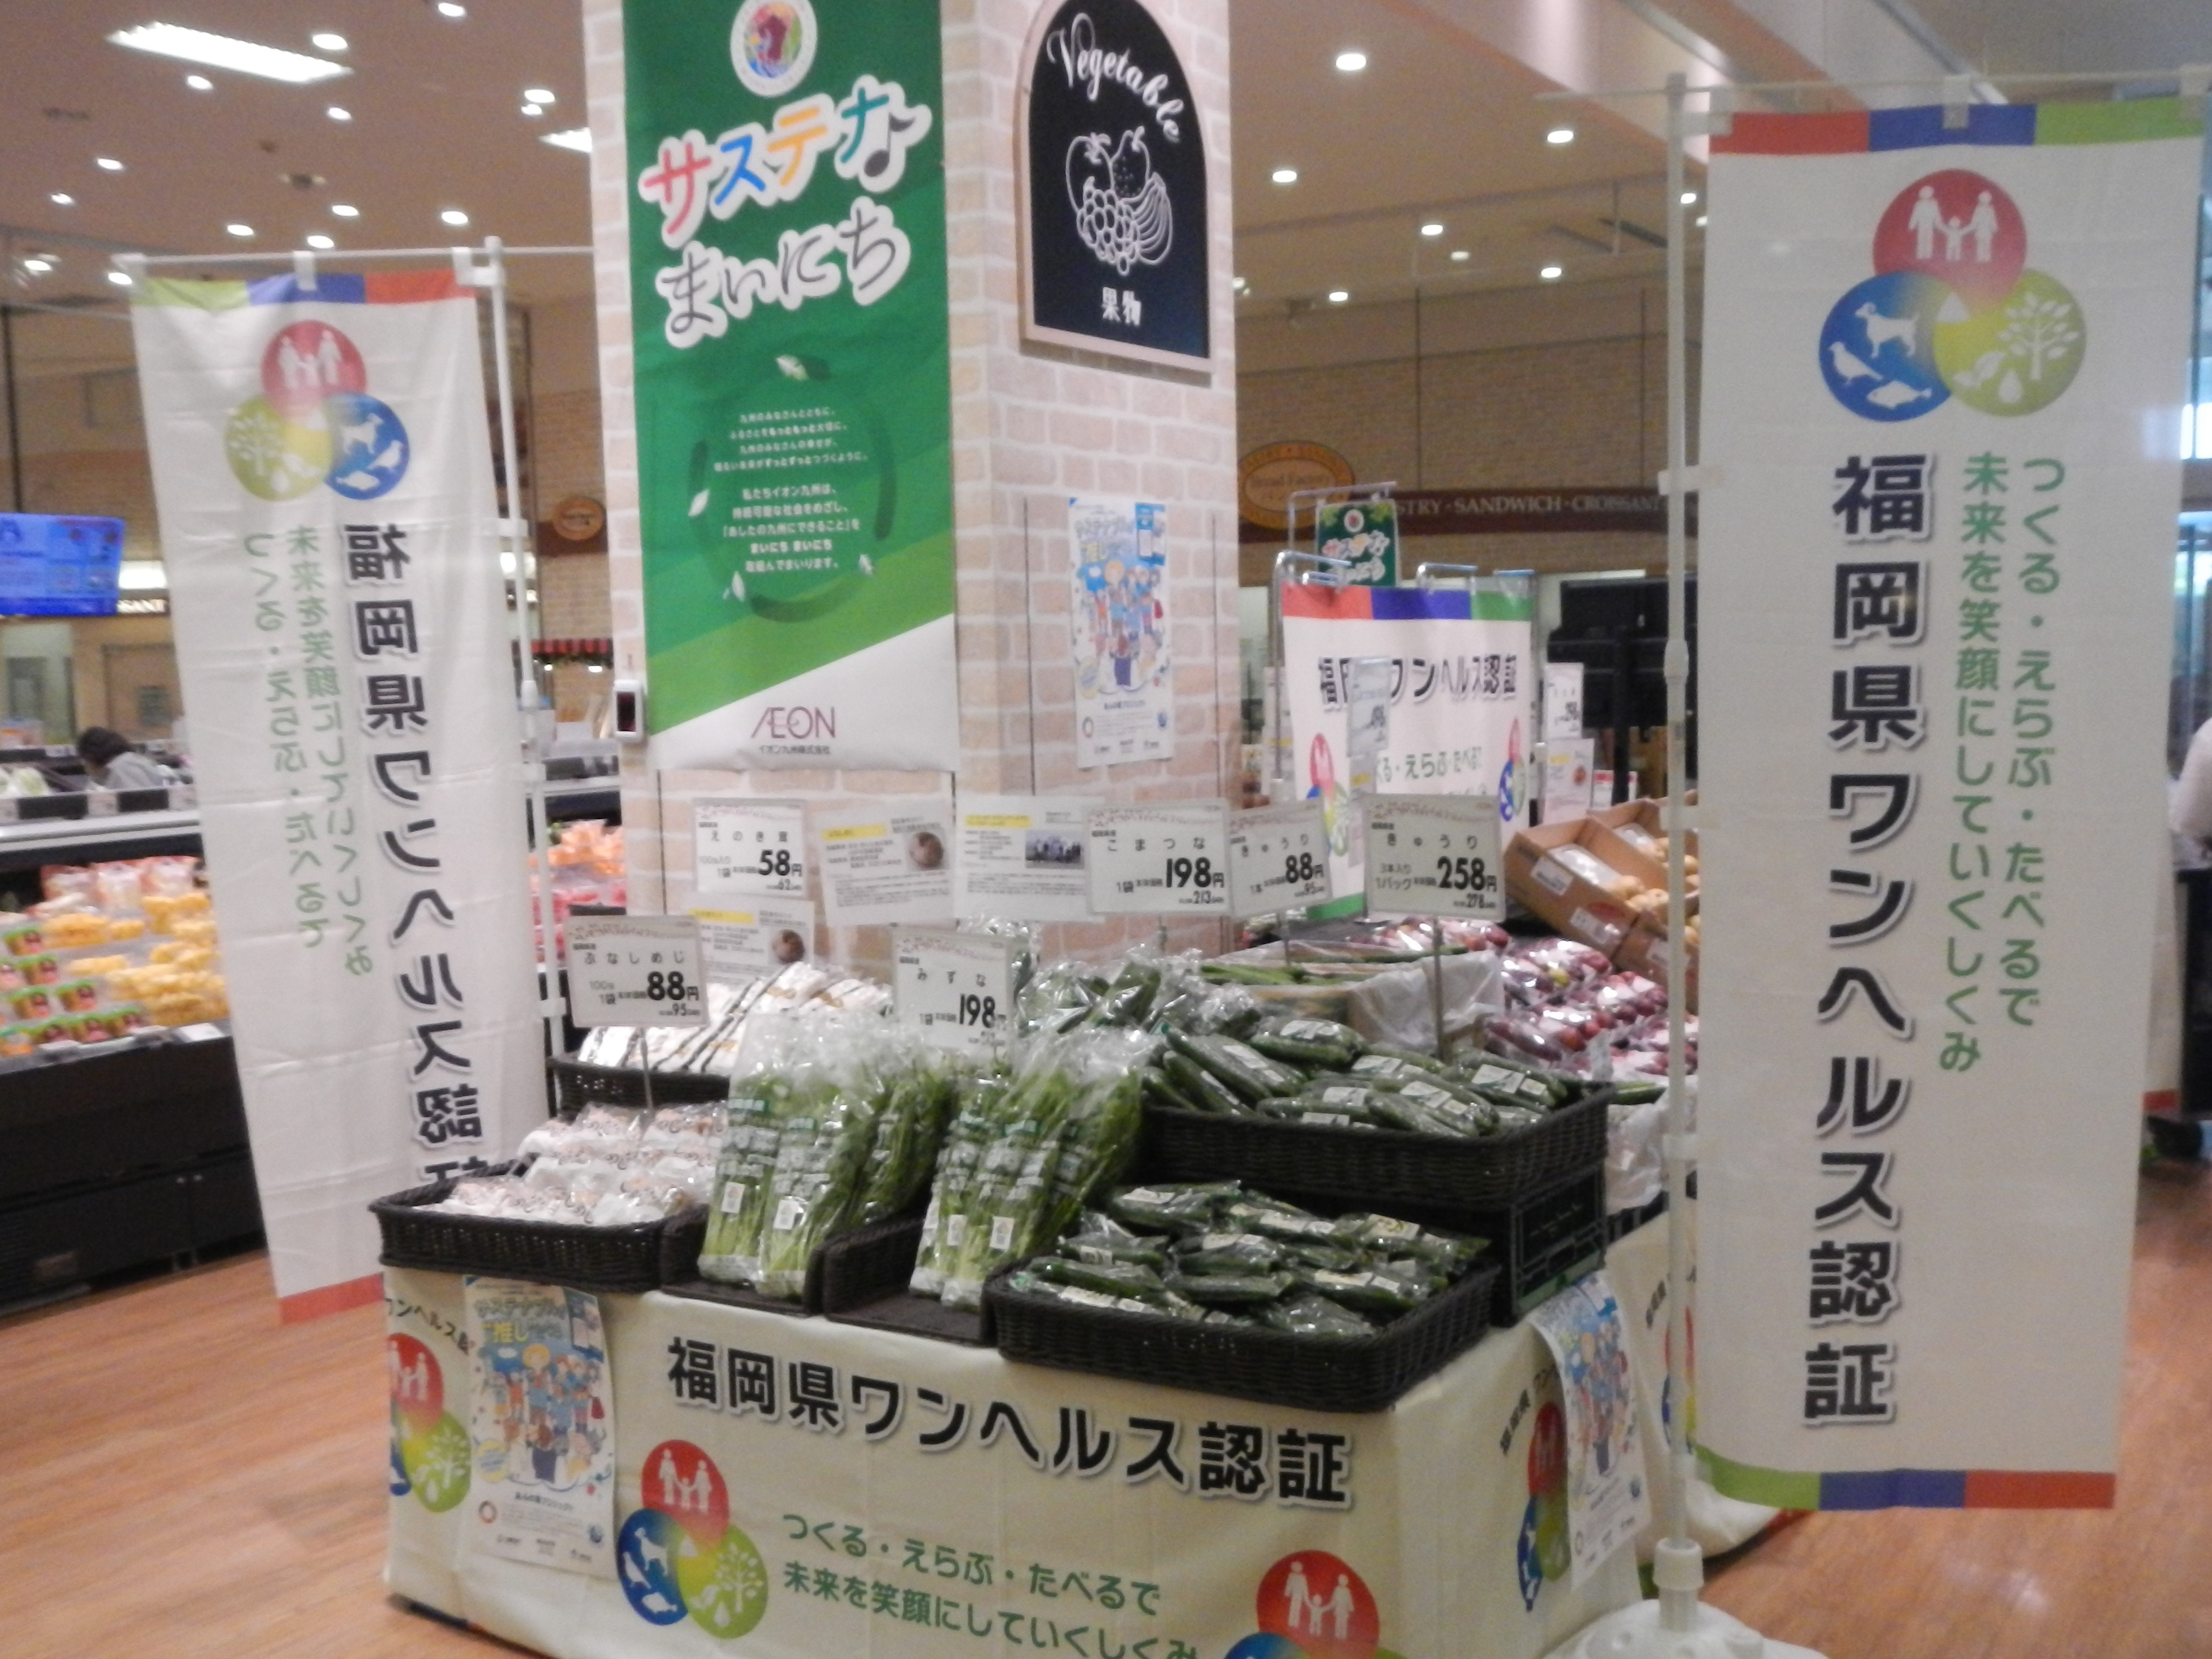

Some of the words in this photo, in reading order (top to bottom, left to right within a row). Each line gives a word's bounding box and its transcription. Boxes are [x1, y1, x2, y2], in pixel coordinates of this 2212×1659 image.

[1046, 12, 1184, 143] Vegetable
[657, 204, 903, 340] まいにち
[1101, 286, 1142, 326] 果物
[1454, 496, 1561, 513] SANDWICH
[1938, 451, 2009, 1072] 未来を笑顔にしていくしくみ
[1804, 454, 1927, 1419] 福岡県ワンヘルス認証
[667, 1336, 1346, 1503] 福岡県ワンヘルス認証
[783, 1560, 1200, 1659] 未来を笑顔にしていくしくみ
